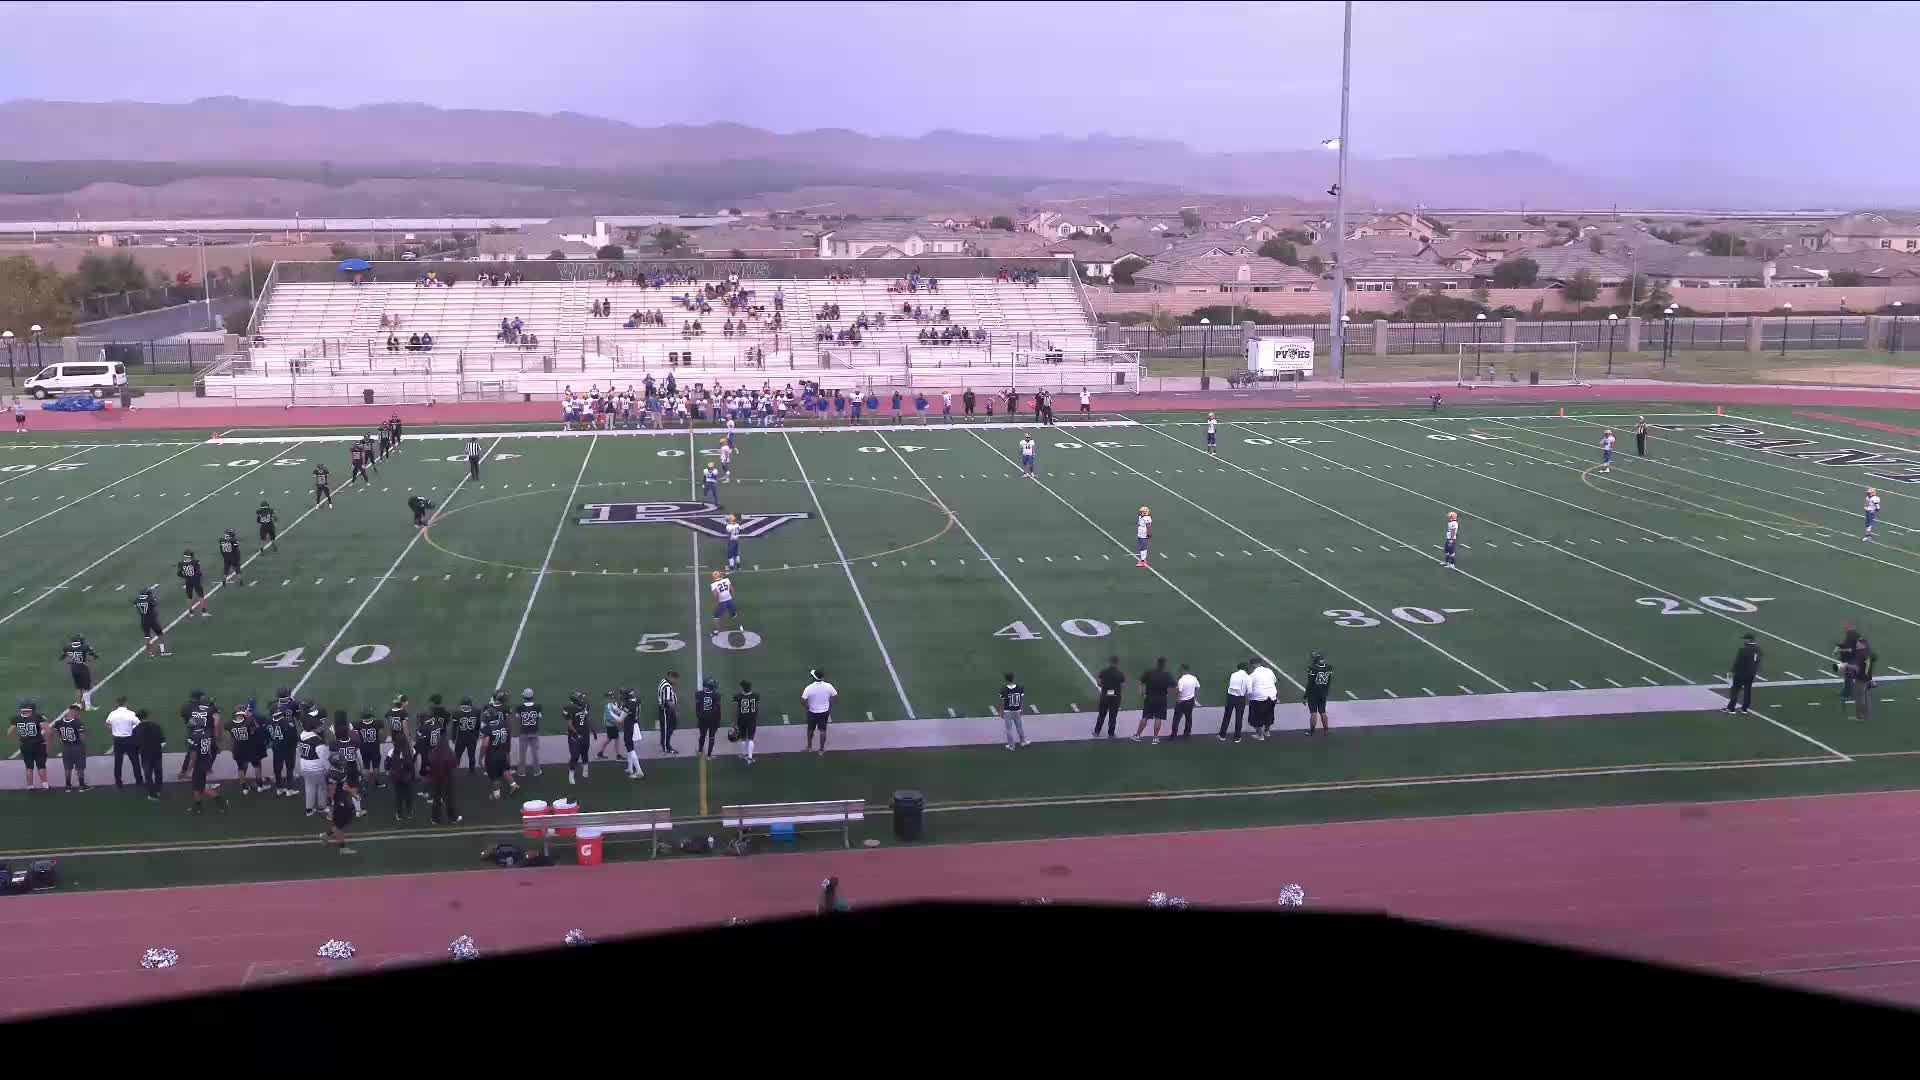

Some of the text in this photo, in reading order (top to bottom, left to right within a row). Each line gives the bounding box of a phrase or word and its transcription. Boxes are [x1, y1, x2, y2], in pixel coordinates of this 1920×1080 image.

[577, 500, 810, 538] PV
[717, 581, 729, 593] 25
[1635, 596, 1759, 615] 20
[1322, 606, 1447, 628] 30
[993, 618, 1112, 641] 40
[635, 630, 762, 653] 50
[251, 644, 391, 669] 40
[740, 698, 756, 713] 21
